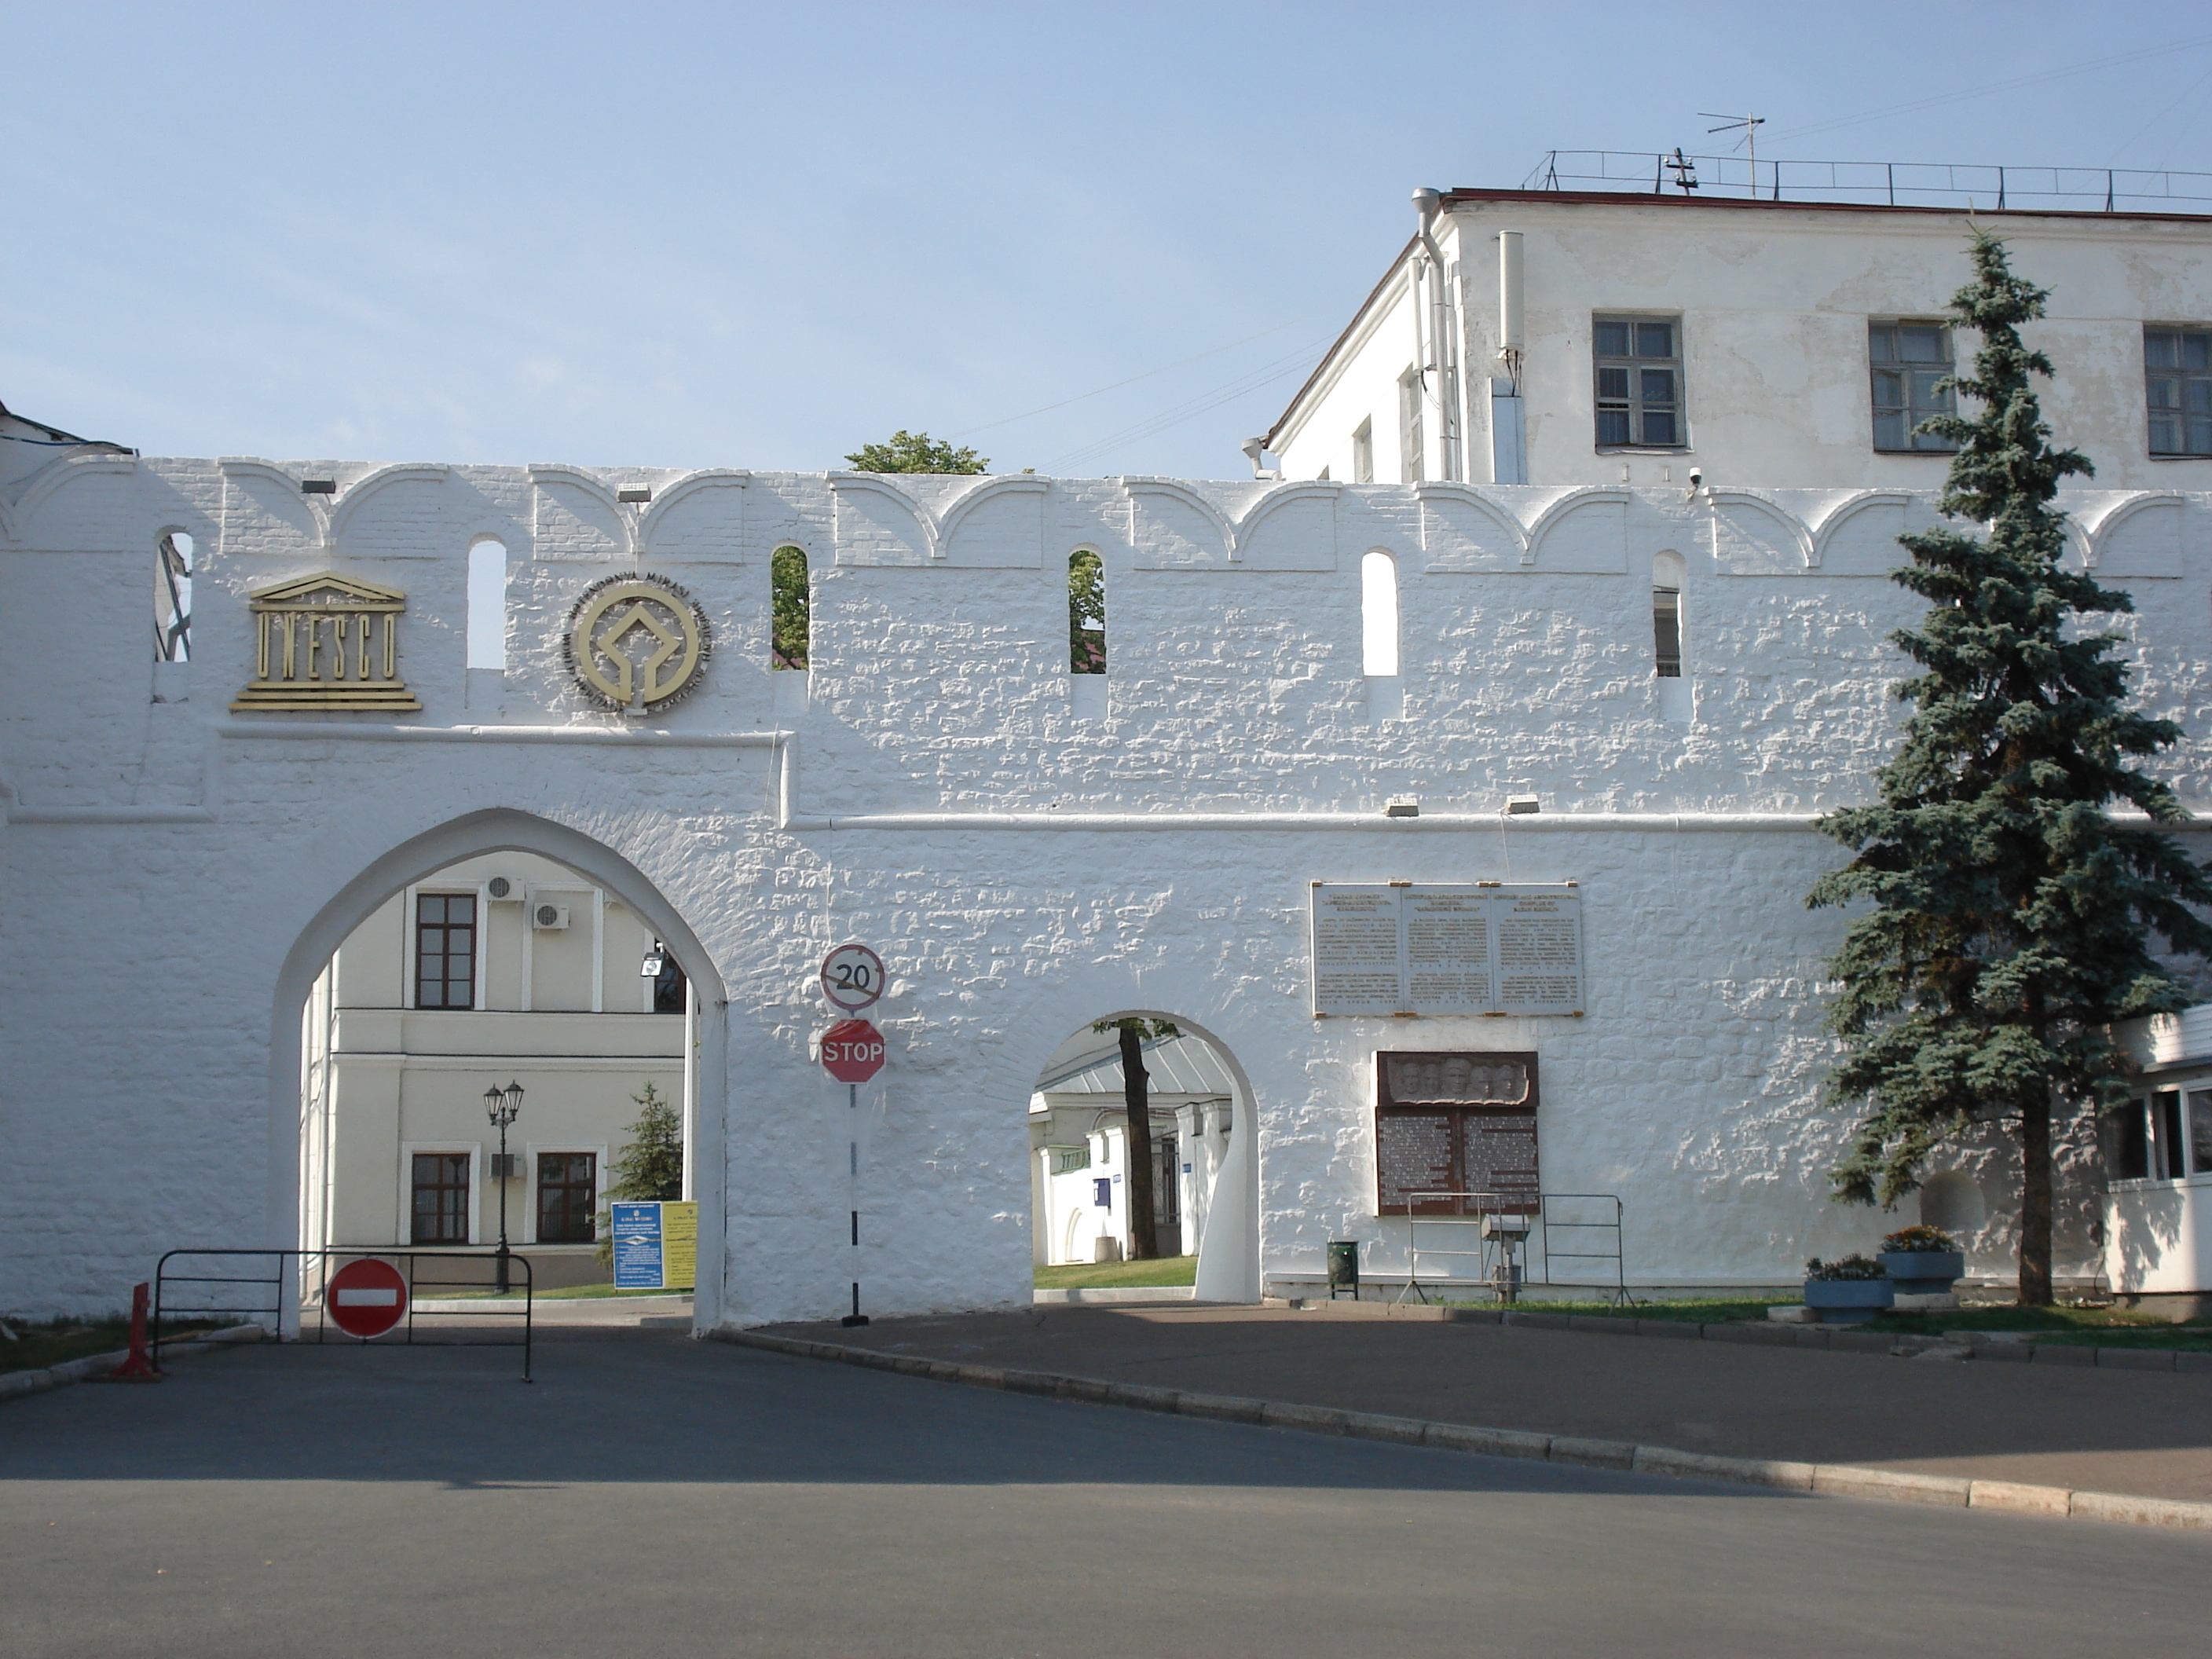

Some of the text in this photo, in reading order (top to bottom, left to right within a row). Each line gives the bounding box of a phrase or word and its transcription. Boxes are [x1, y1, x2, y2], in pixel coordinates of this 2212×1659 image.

[257, 613, 395, 679] UNESCO
[690, 599, 712, 662] НАСЛЕДИЕ
[562, 633, 576, 675] WORLD
[836, 964, 870, 990] 20
[824, 1042, 883, 1062] STOP
